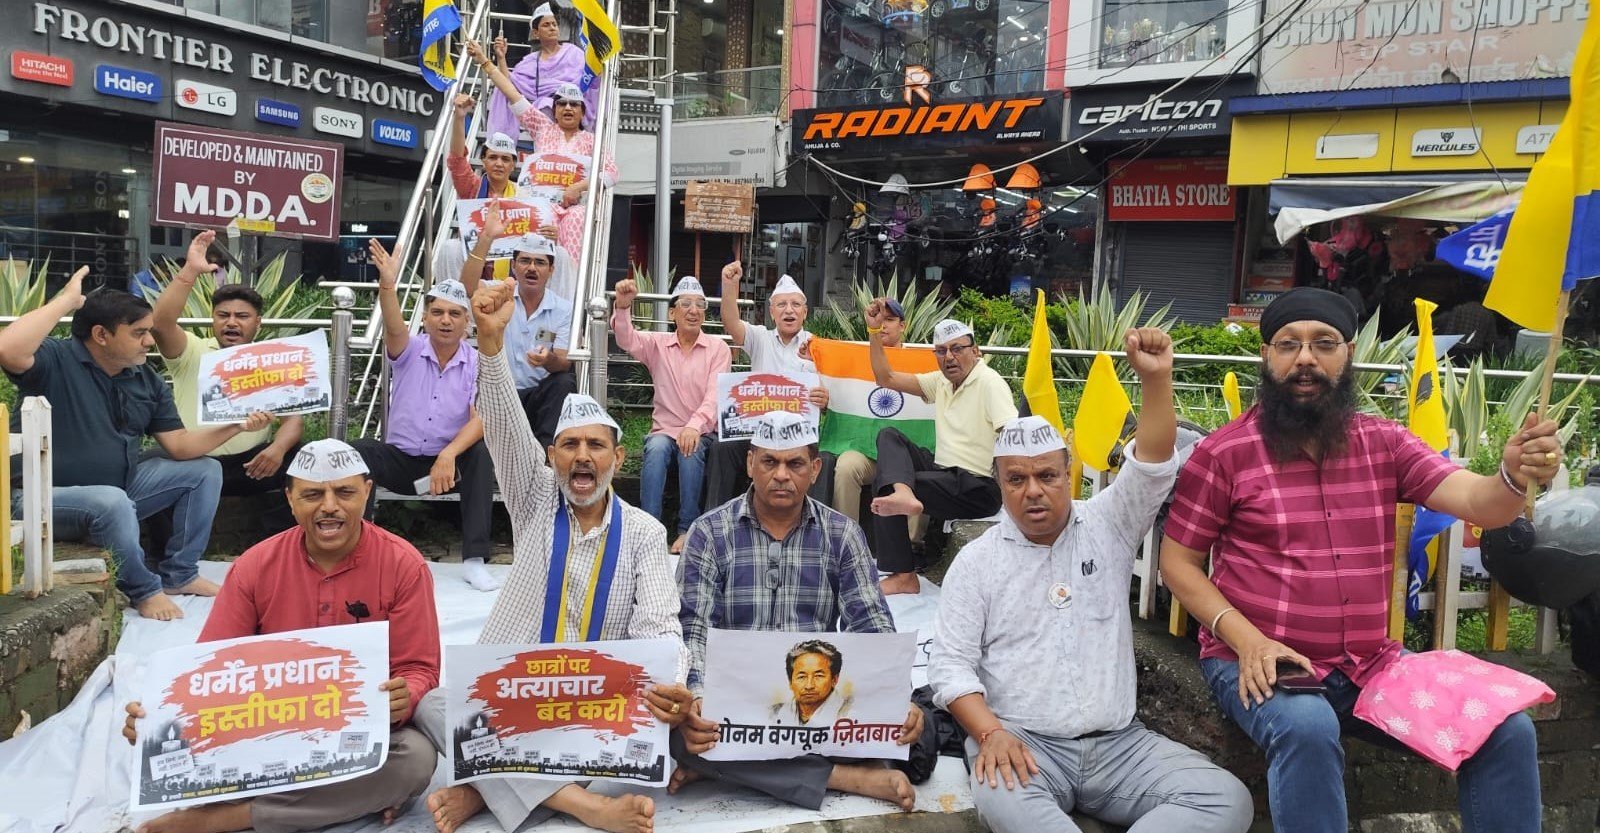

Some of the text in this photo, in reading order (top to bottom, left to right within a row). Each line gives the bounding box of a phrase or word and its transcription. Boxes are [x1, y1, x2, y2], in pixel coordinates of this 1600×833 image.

[21, 58, 66, 73] HITACHI
[33, 2, 435, 118] FRONTIER ELECTRONIC
[104, 71, 154, 96] Haier
[207, 92, 227, 108] LG
[260, 104, 300, 121] SAMSUNG
[1078, 94, 1223, 125] carlton
[320, 113, 358, 131] SONY
[802, 97, 1045, 140] RADIANT
[1189, 122, 1217, 131] SPORTS
[378, 123, 412, 143] VOLTAS
[163, 136, 324, 173] DEVELOPED & MAINTAINED
[1415, 142, 1477, 153] HERCULES
[234, 170, 256, 186] BY
[174, 181, 317, 226] M.D.D.A.
[1112, 183, 1231, 207] BHATIA STORE
[260, 349, 304, 368] प्रधान
[230, 367, 286, 392] इस्तीफा
[287, 364, 304, 381] दो
[766, 384, 801, 397] प्रधान
[743, 397, 801, 412] इस्तीफा दो
[261, 655, 343, 691] प्रधान
[525, 654, 592, 682] छात्रों पर
[496, 675, 606, 700] अत्याचार
[198, 684, 343, 738] इस्तीफा दो
[535, 694, 628, 722] बंद करो
[768, 719, 831, 751] वंगचूक
